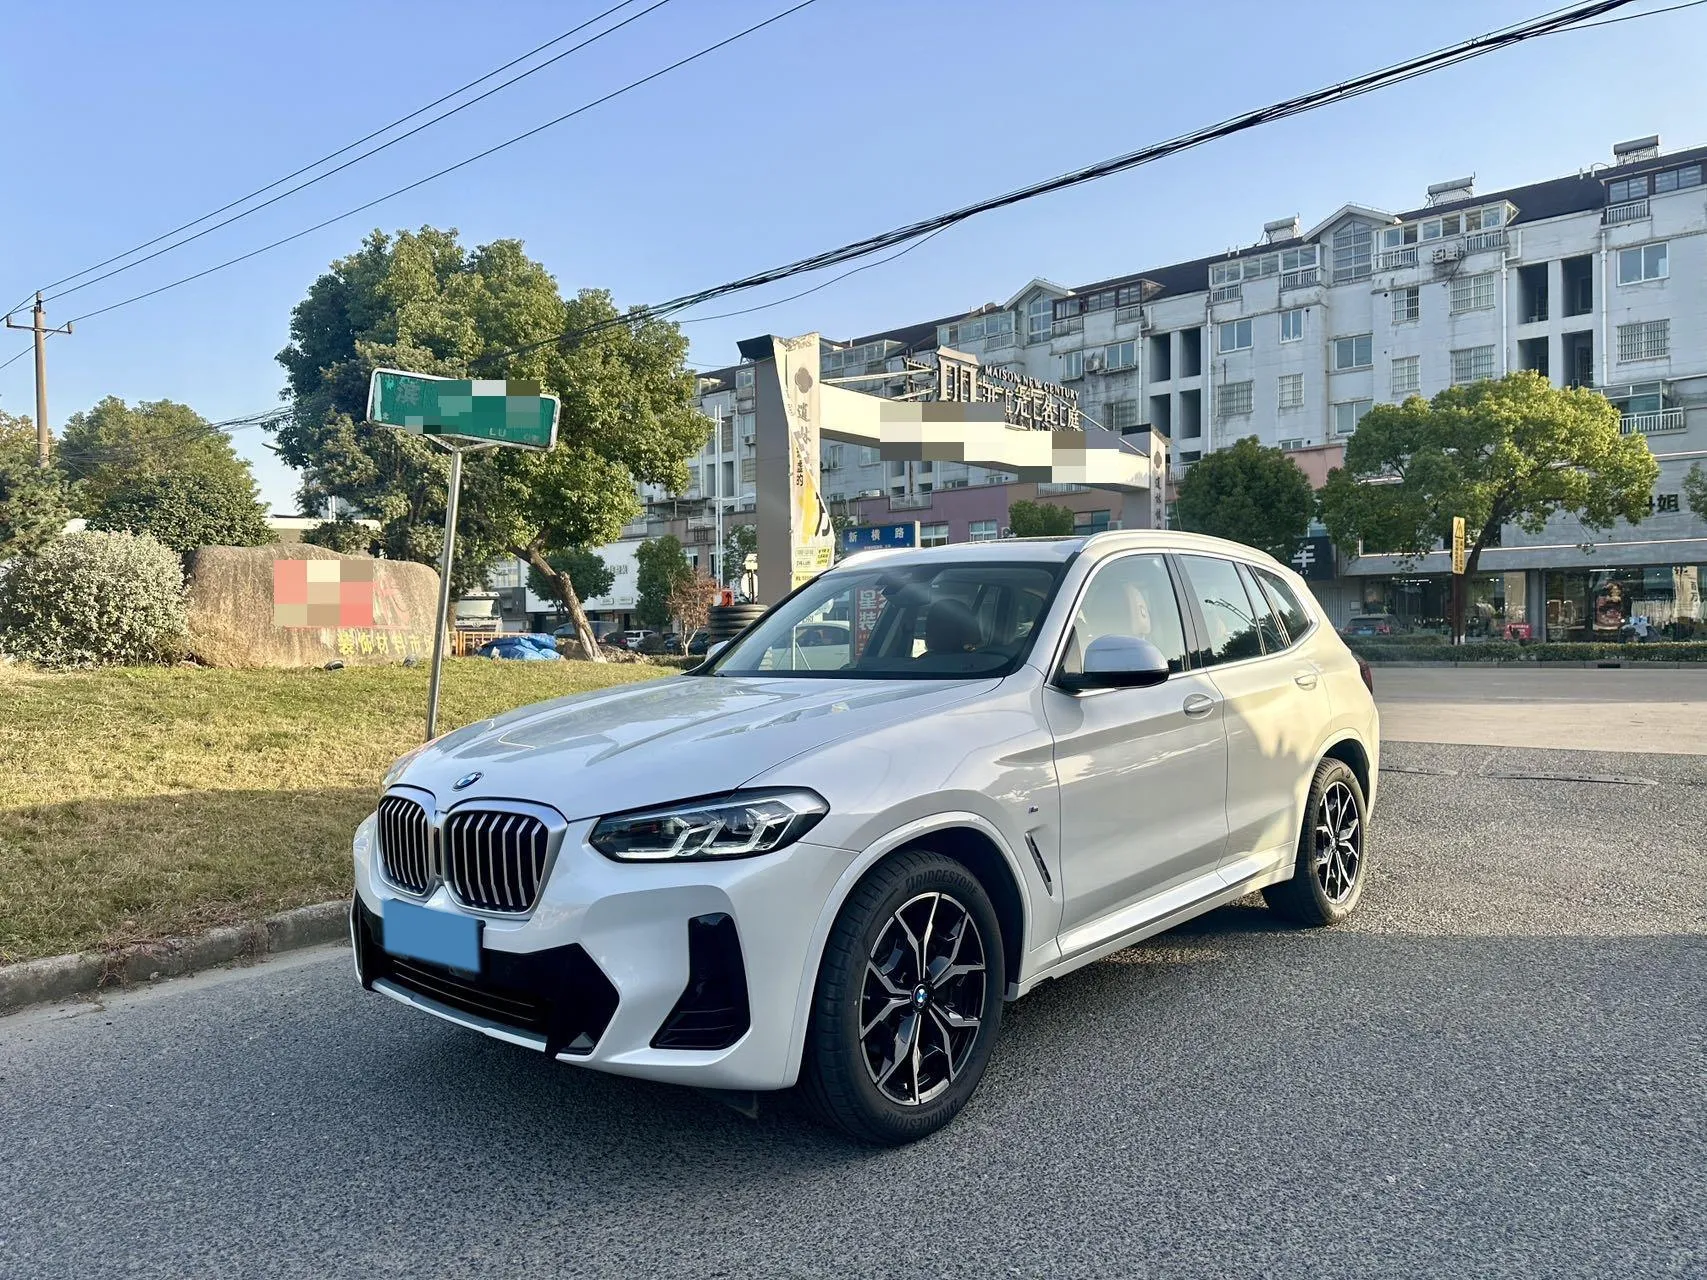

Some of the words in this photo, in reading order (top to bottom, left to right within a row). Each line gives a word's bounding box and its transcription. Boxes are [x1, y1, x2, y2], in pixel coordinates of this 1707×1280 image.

[985, 364, 1020, 384] MAISON
[1022, 375, 1042, 389] NEW
[1044, 381, 1080, 401] CENTURY
